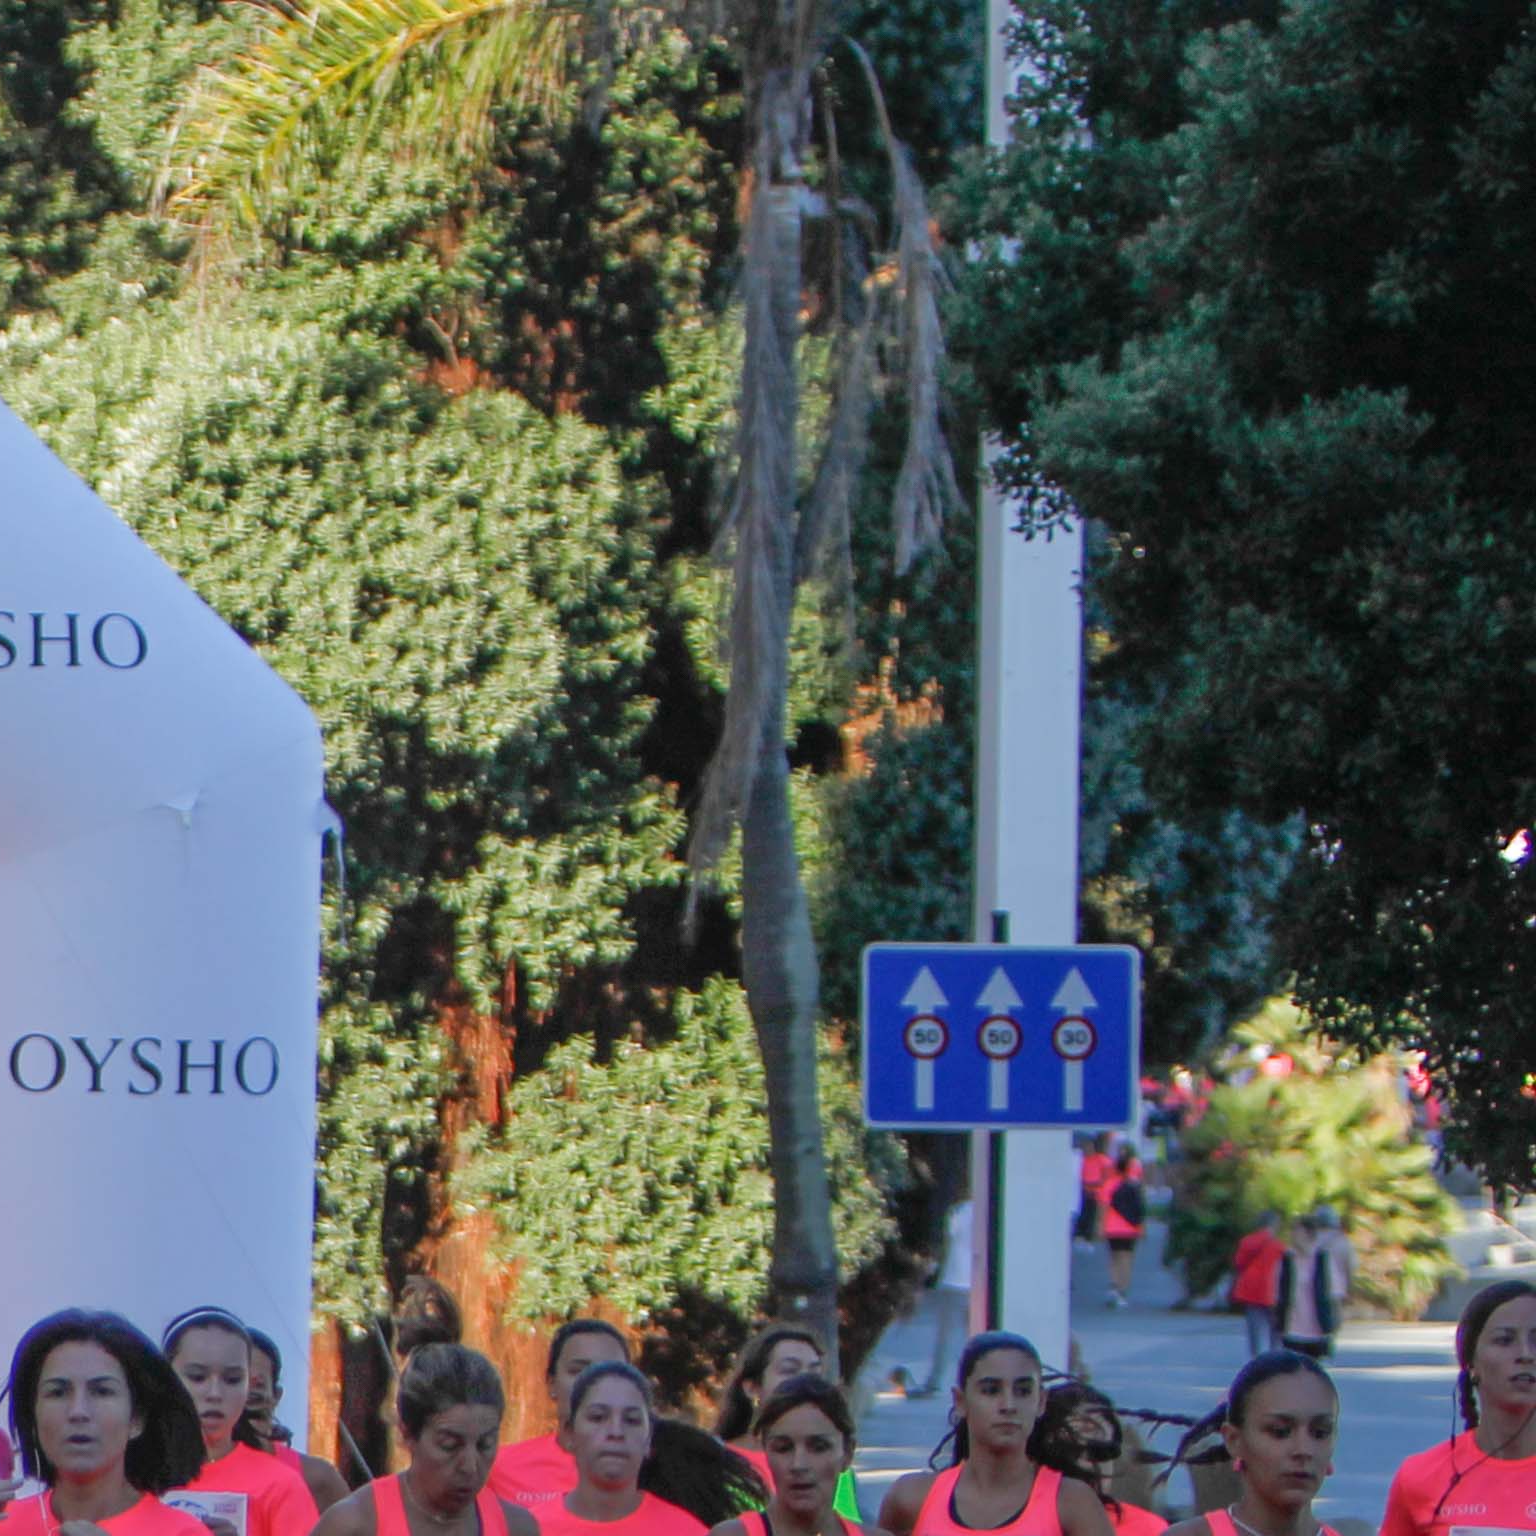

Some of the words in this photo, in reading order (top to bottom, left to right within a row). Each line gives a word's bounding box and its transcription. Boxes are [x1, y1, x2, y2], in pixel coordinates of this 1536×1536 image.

[914, 1029, 940, 1045] 50
[988, 1029, 1013, 1045] 50
[1064, 1029, 1089, 1045] 30
[9, 1033, 280, 1096] OYSHO
